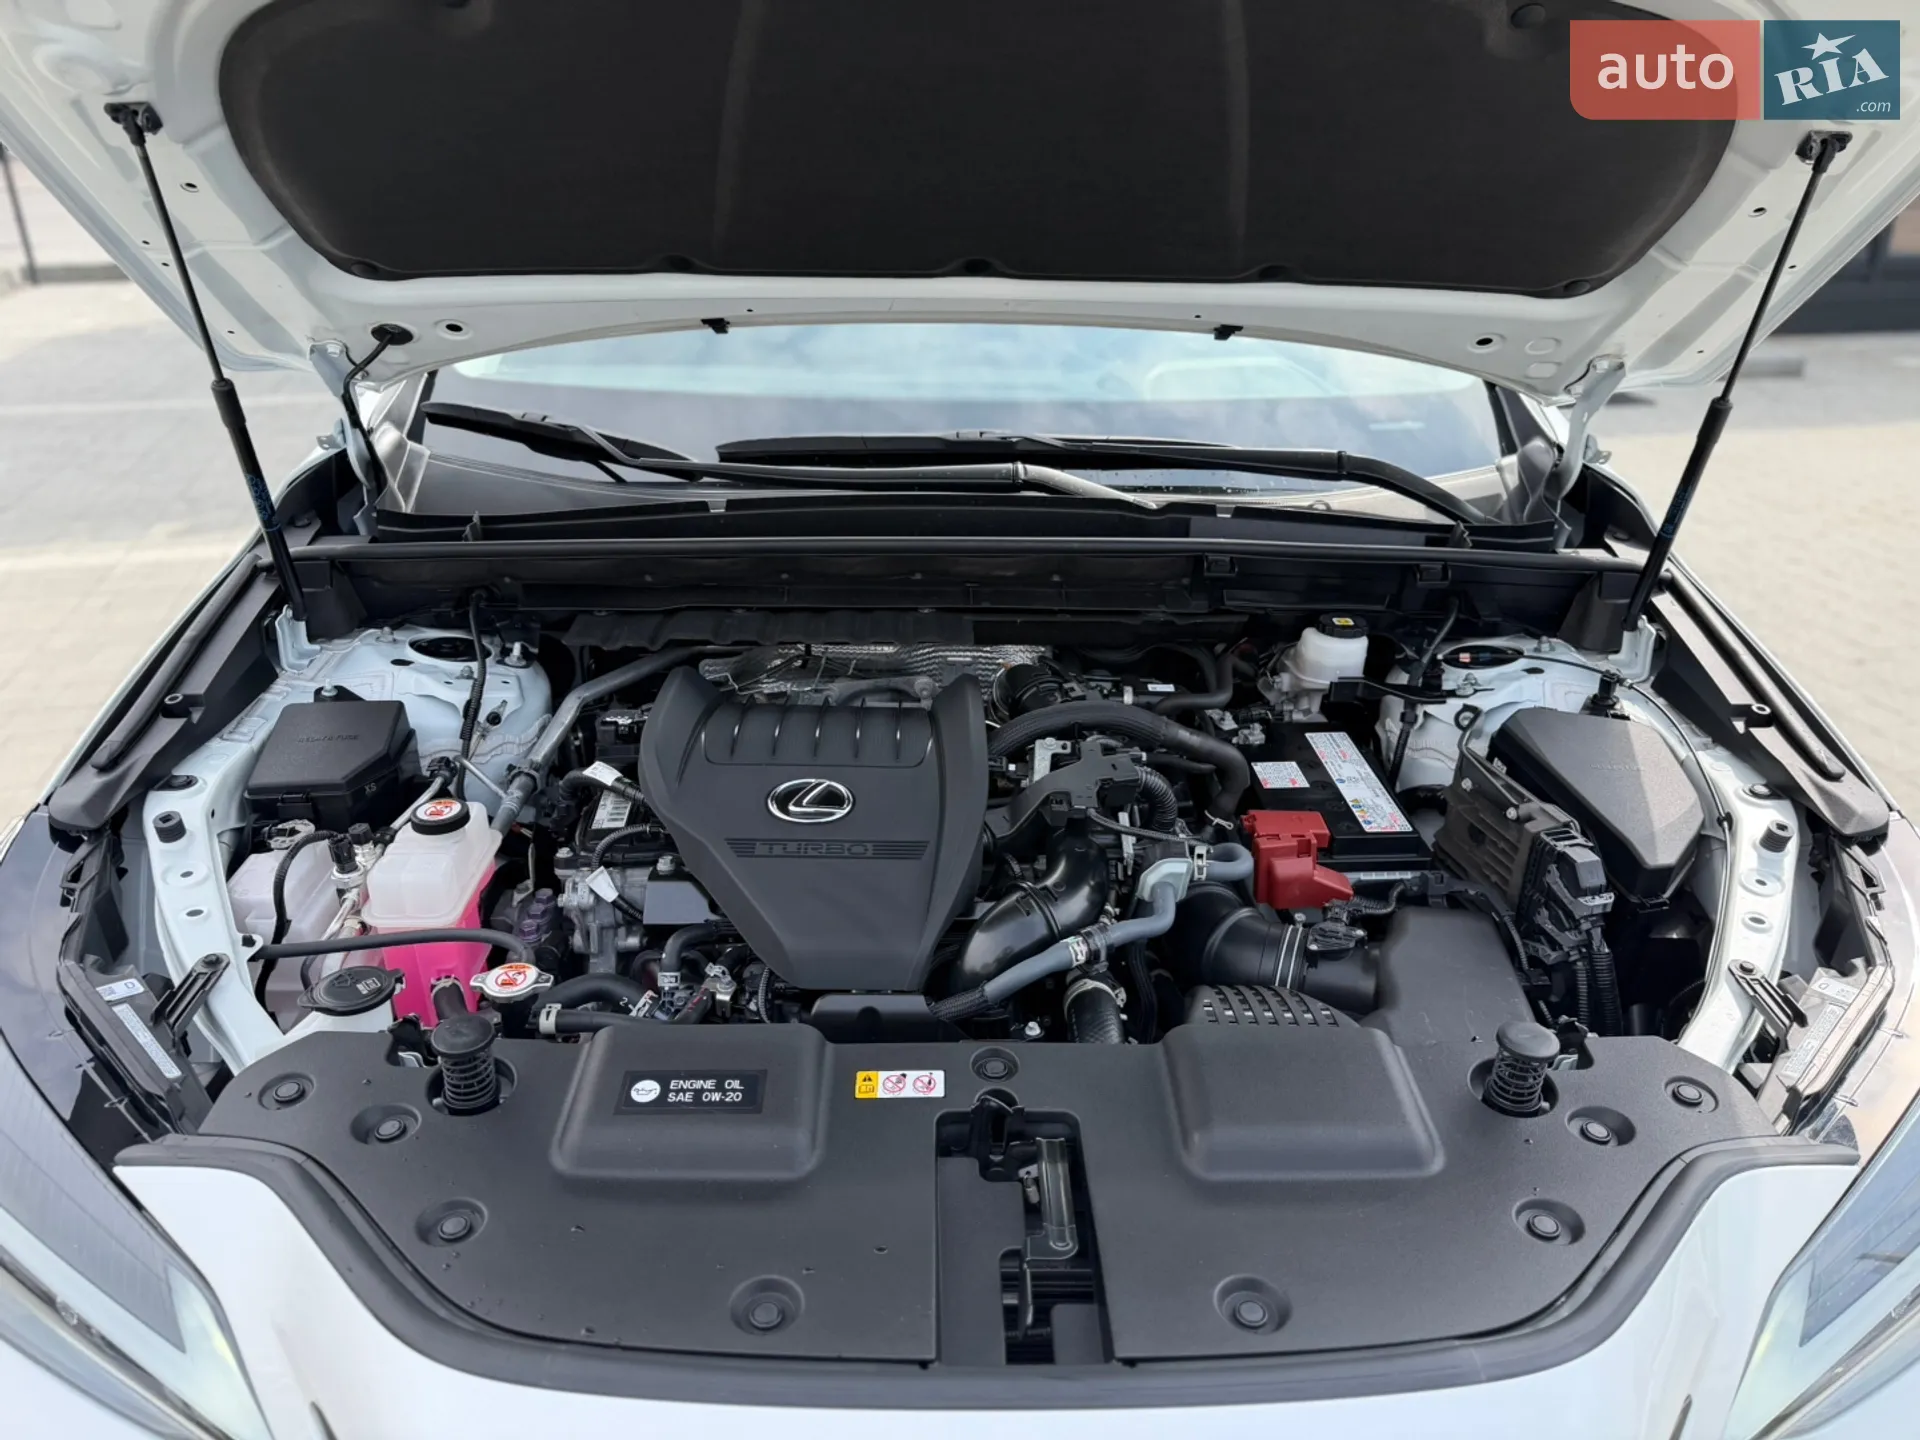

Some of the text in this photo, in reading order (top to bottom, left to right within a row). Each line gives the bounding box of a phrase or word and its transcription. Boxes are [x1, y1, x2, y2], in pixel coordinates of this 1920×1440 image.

[757, 842, 869, 856] TURBO
[124, 981, 136, 989] D
[669, 1079, 744, 1090] ENGINE OIL
[667, 1091, 743, 1102] SAE 0W-20
